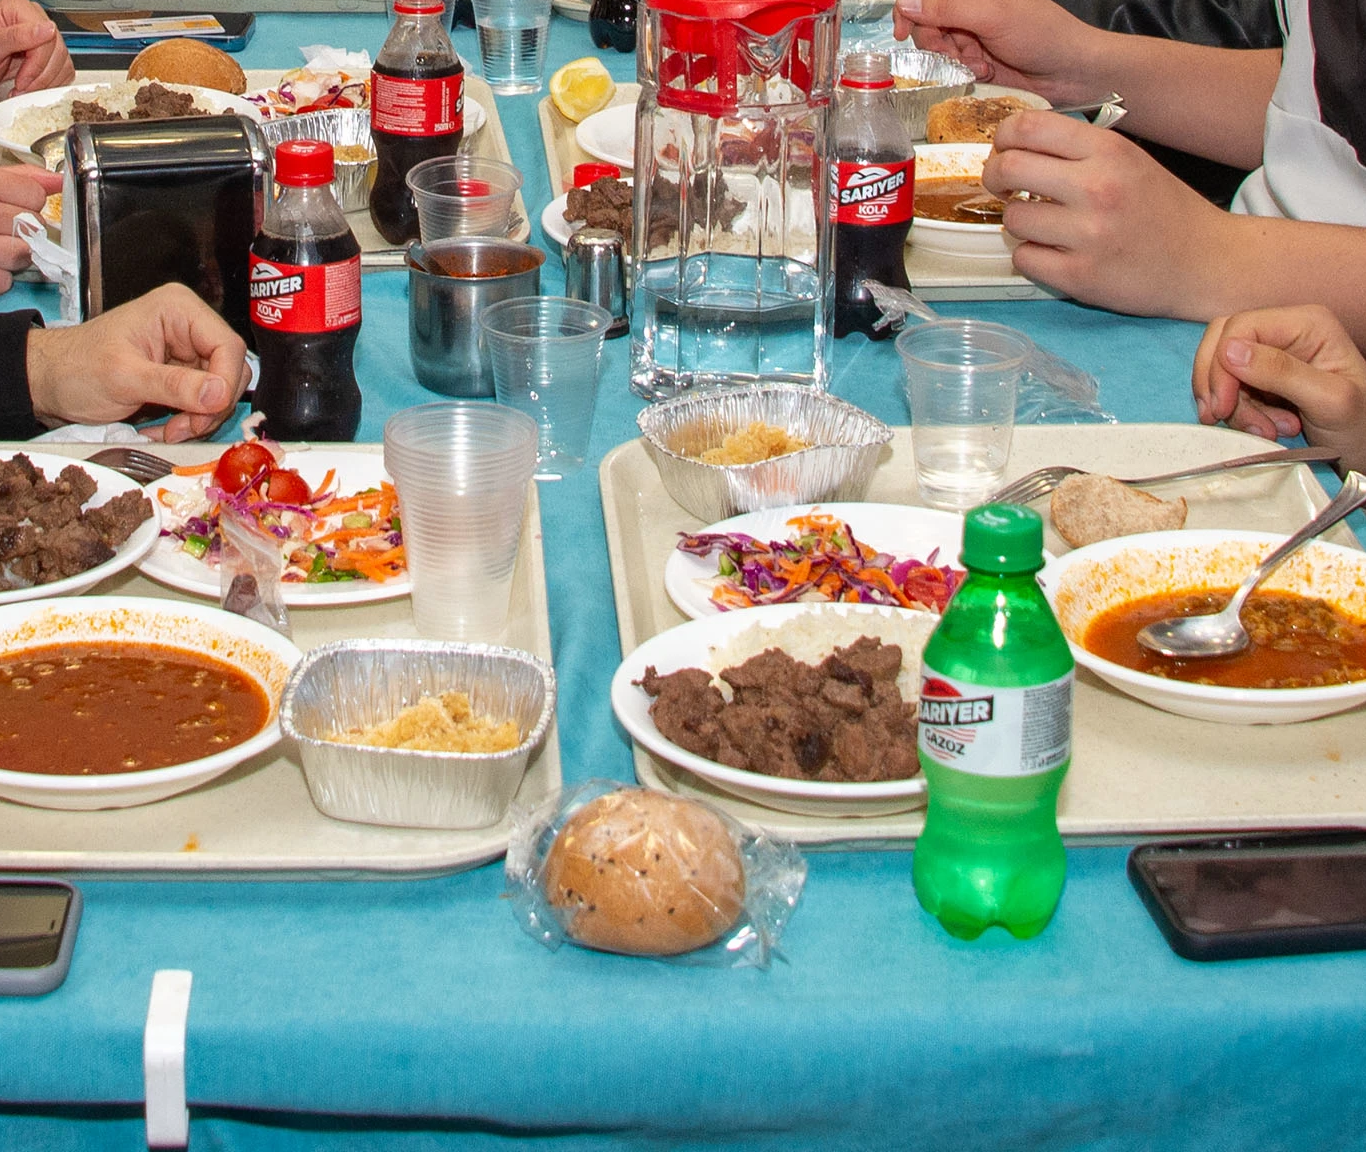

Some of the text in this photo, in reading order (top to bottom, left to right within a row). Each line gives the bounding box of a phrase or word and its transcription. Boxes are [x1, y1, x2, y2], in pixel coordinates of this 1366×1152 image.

[840, 171, 905, 204] SARIYER
[858, 205, 888, 214] KOLA
[257, 302, 282, 319] KOLA
[925, 728, 965, 755] GAZOZ
